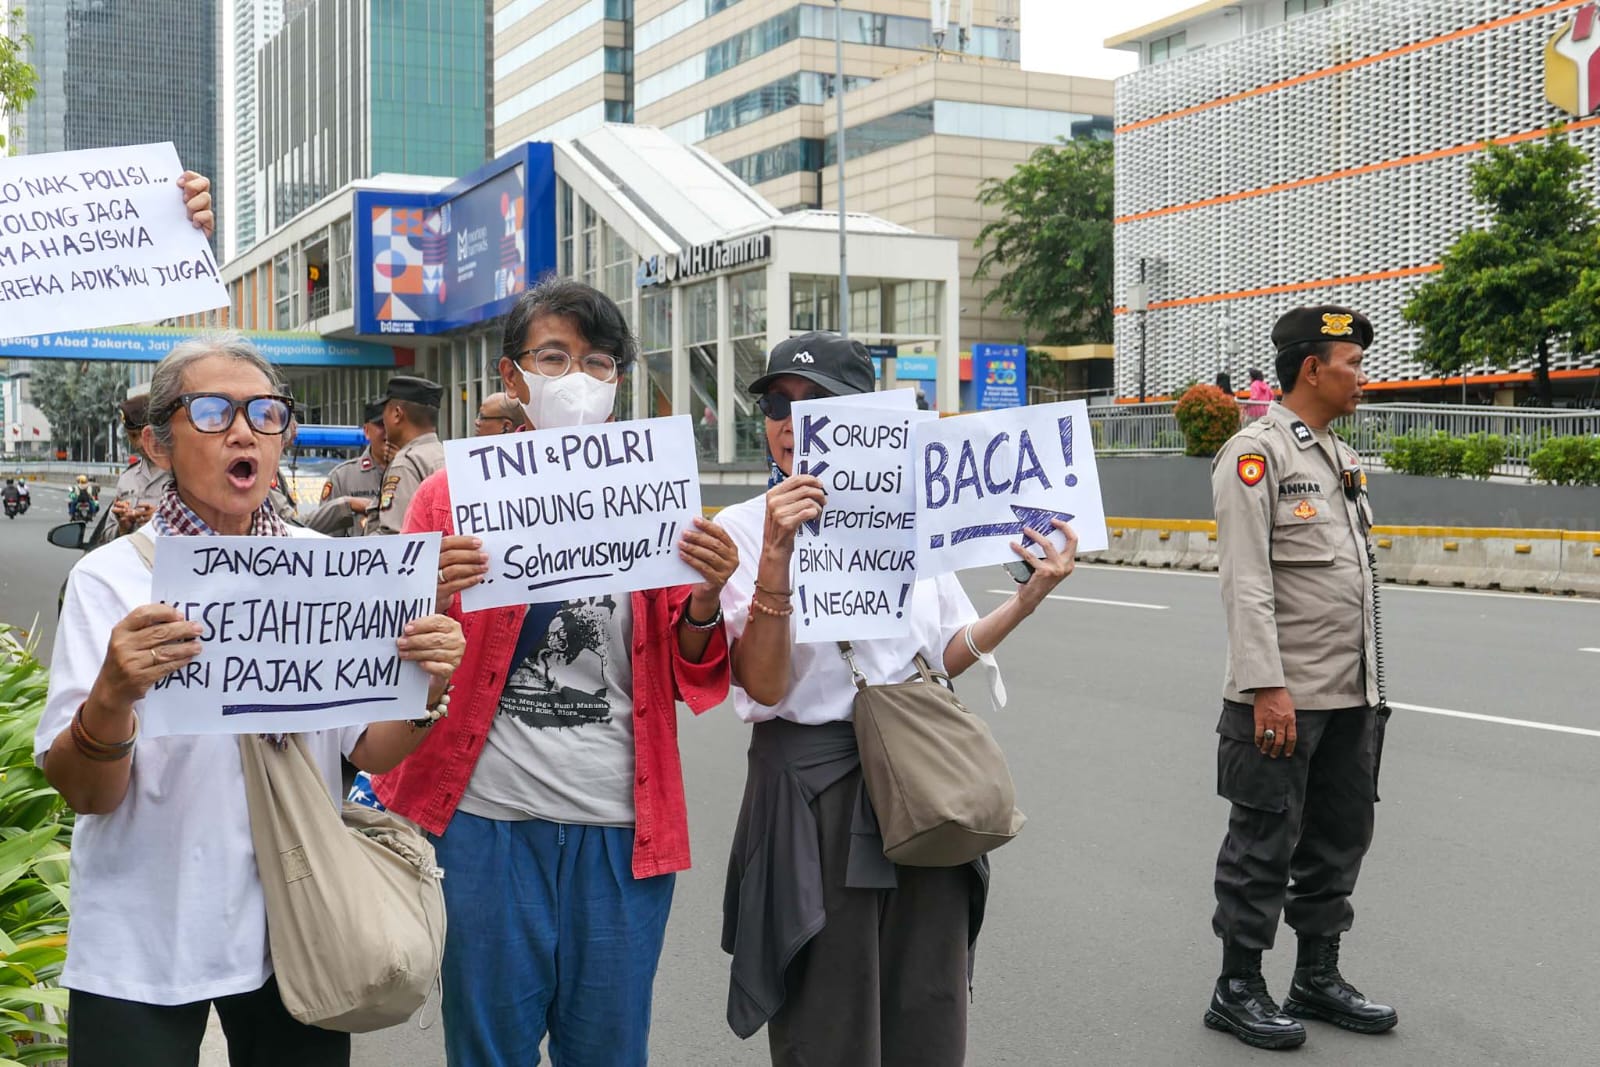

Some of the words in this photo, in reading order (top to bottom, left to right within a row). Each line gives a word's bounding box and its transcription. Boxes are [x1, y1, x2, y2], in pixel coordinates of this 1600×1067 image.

[0, 206, 79, 236] OLONG
[83, 198, 139, 224] JAGA
[152, 249, 220, 287] JUGA!
[54, 336, 88, 348] Abad
[91, 337, 144, 352] Jakarta,
[147, 339, 170, 351] Jati
[469, 440, 538, 481] TNI
[456, 489, 594, 536] PELINDUNG
[603, 479, 690, 519] RAKYAT
[193, 547, 313, 578] JANGAN
[325, 548, 389, 576] LUPA
[847, 549, 916, 573] ANCUR
[814, 590, 890, 617] NEGARA
[222, 656, 323, 693] PAJAK
[335, 655, 401, 690] KAMI
